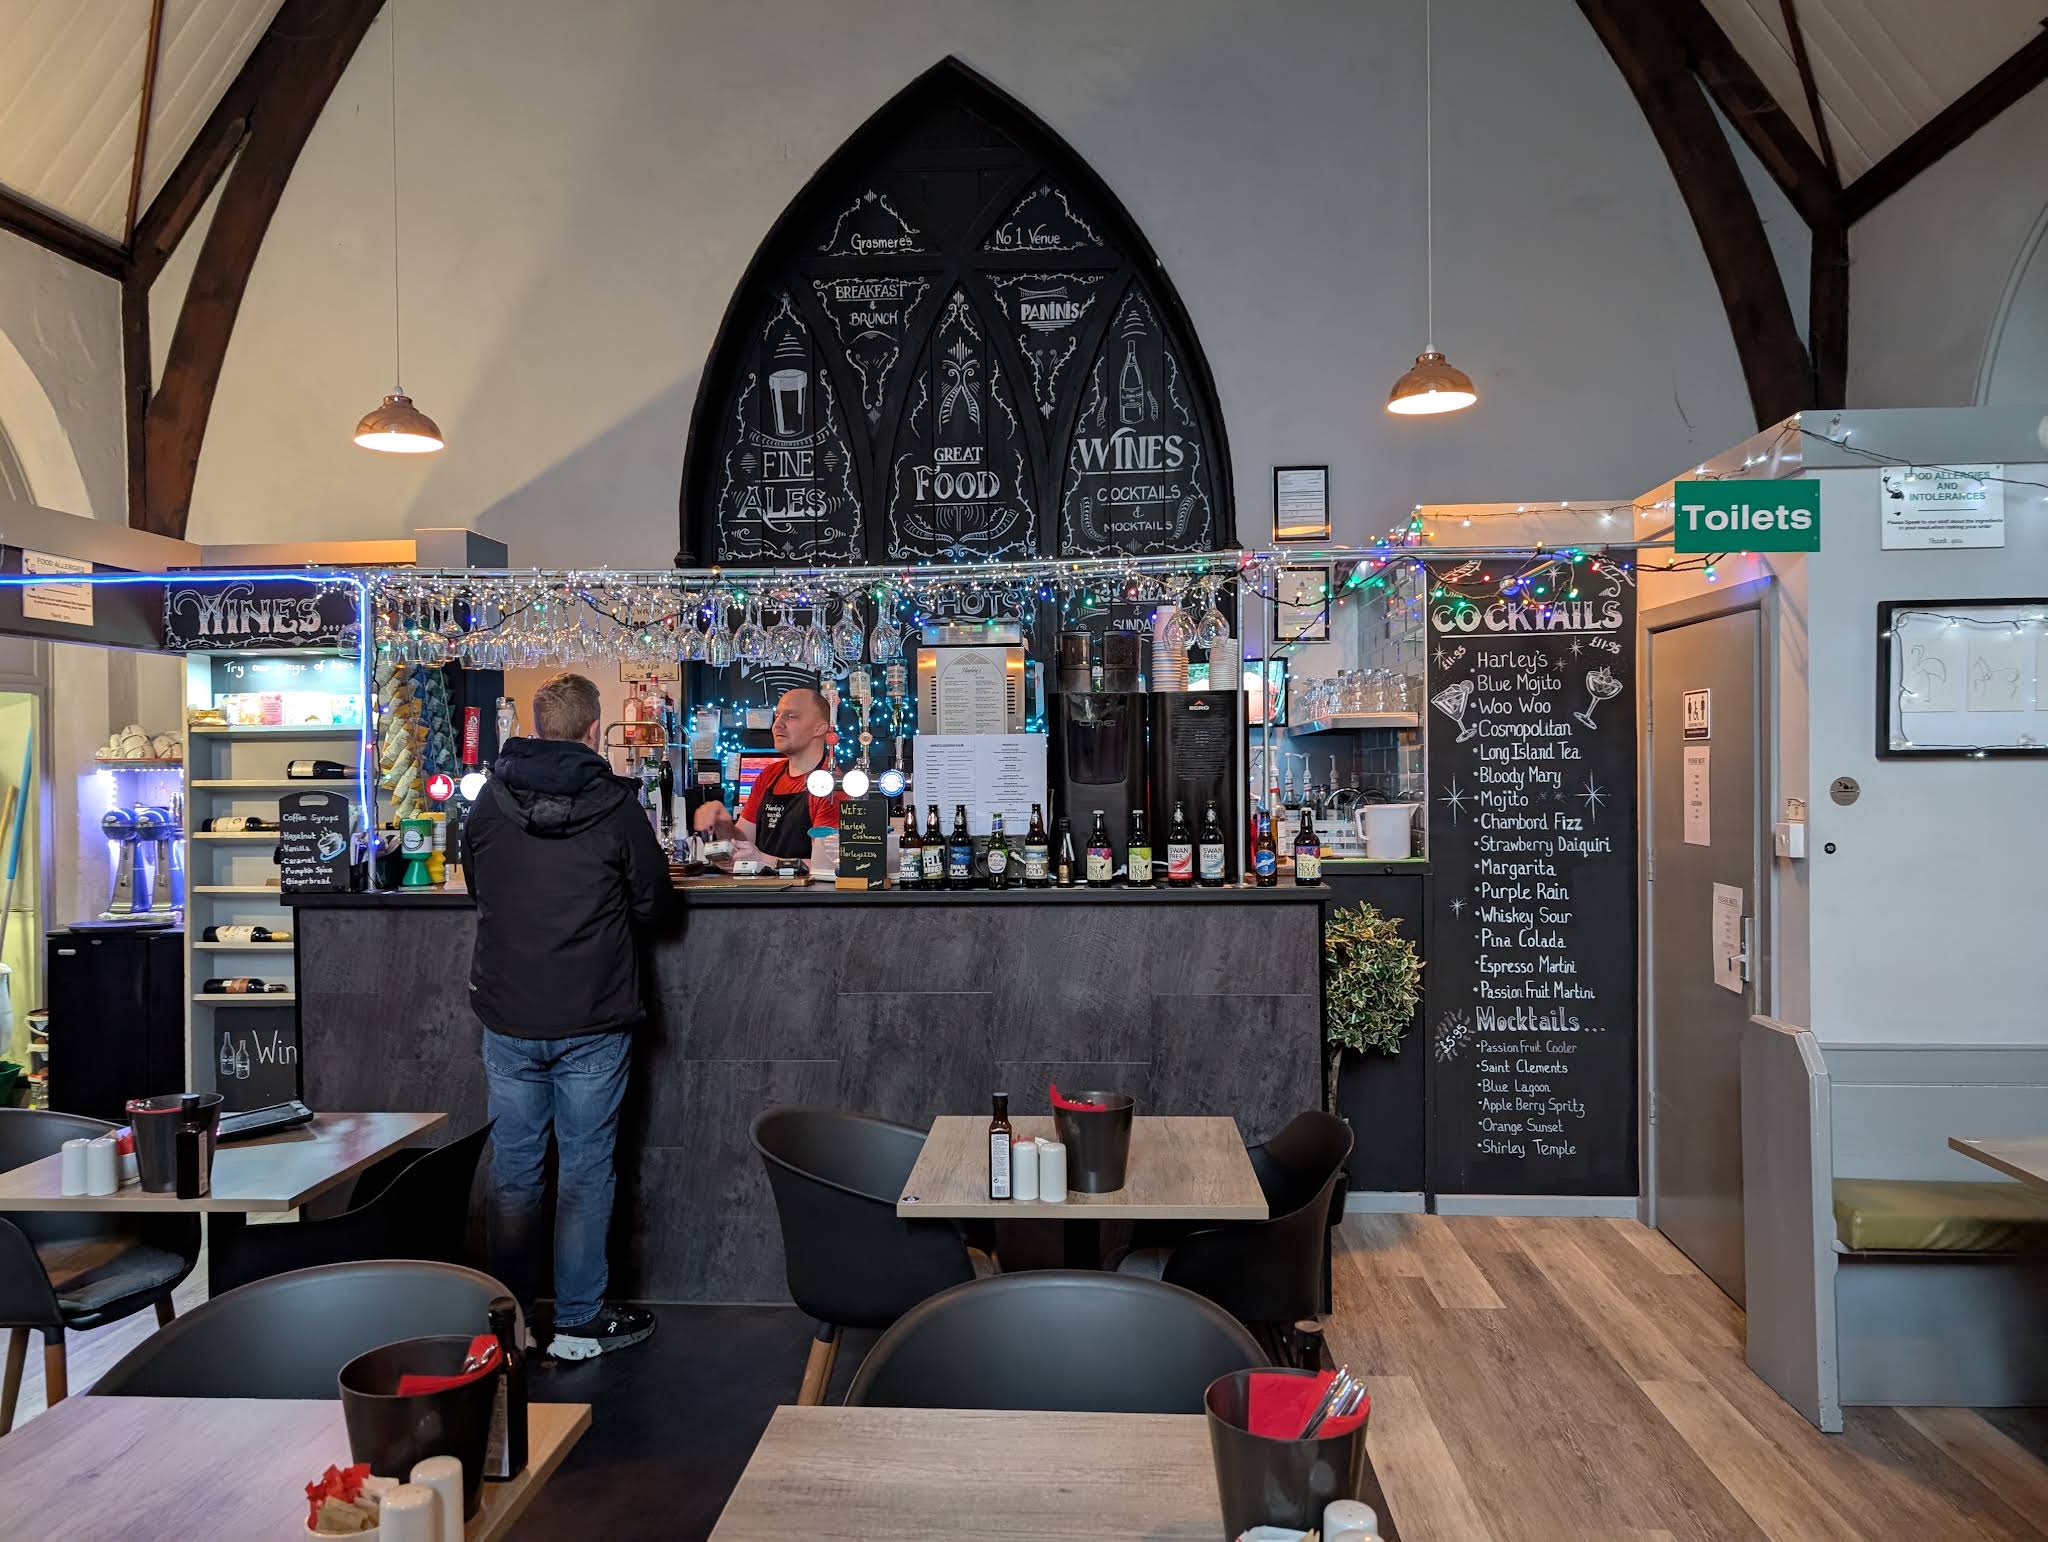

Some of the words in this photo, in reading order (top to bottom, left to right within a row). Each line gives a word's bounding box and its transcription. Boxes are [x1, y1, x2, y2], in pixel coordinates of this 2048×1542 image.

[996, 222, 1014, 245] No
[1016, 227, 1022, 245] 1
[1028, 223, 1062, 245] Venue
[851, 234, 913, 256] Grasmere's
[835, 282, 907, 299] BREAKFAST
[850, 310, 898, 328] BRUNCH
[1021, 301, 1081, 321] PANINIS
[934, 446, 984, 462] GREAT
[1077, 427, 1184, 470] WINES
[763, 450, 814, 478] FINE
[913, 465, 1001, 501] FOOD
[1904, 472, 1933, 481] FOOD
[1935, 471, 1991, 480] ALLERGIES
[1097, 484, 1182, 502] COCKTAILS
[1937, 482, 1958, 490] AND
[737, 485, 827, 520] ALES
[1909, 492, 1986, 501] INTOLERANCES
[1104, 521, 1173, 533] MOCKTAILS
[1682, 504, 1813, 531] Toilets
[37, 557, 53, 566] FOOD
[916, 590, 1024, 618] SHOTS
[1431, 600, 1623, 633] COCKTAILS
[223, 661, 244, 679] Try
[314, 660, 325, 672] of
[1477, 650, 1549, 674] Harley's
[1477, 674, 1512, 692] Blue
[1516, 673, 1562, 696] Mojito
[1478, 696, 1512, 714] Woo
[1519, 696, 1552, 714] Woo
[1478, 719, 1573, 743] Cosmopolitan
[1480, 743, 1510, 766] Long
[1510, 742, 1555, 760] Island
[1557, 741, 1581, 760] Tea
[1480, 766, 1525, 791] Bloody
[1528, 765, 1562, 789] Mary
[1480, 789, 1529, 812] Mojito
[282, 813, 307, 822] Coffee
[311, 814, 339, 824] Syrups
[840, 820, 866, 834] Harley's
[1480, 812, 1549, 831] Chambord
[1554, 812, 1584, 831] Fizz
[283, 844, 311, 852] Vanilla
[1480, 835, 1553, 858] Strawberry
[1558, 836, 1612, 858] Daiquiri
[283, 856, 317, 864] Caramel
[923, 856, 942, 868] FELL
[1480, 858, 1557, 880] Margarita
[285, 867, 314, 877] Pumpkin
[316, 866, 333, 875] Spice
[285, 877, 331, 886] Gingerbread
[1481, 882, 1533, 904] Purple
[1536, 882, 1570, 900] Rain
[1480, 906, 1534, 931] Whiskey
[1539, 906, 1573, 924] Sour
[1481, 927, 1513, 948] Pina
[1518, 928, 1567, 949] Colada
[1480, 954, 1534, 979] Espresso
[1538, 955, 1577, 974] Martini
[1480, 980, 1524, 999] Passion
[1525, 980, 1550, 999] Fruit
[1553, 981, 1596, 999] Martini
[1480, 1040, 1520, 1054] Passion
[1520, 1040, 1542, 1053] Fruit
[1546, 1040, 1578, 1054] Cooler
[1480, 1060, 1510, 1073] Saint
[1516, 1059, 1568, 1074] Clements
[1482, 1078, 1509, 1093] Blue
[1514, 1079, 1551, 1097] Lagoon
[1482, 1097, 1512, 1114] Apple
[1515, 1097, 1545, 1115] Berry
[1548, 1097, 1586, 1119] Spritz
[1482, 1117, 1523, 1136] Orange
[1526, 1118, 1564, 1132] Sunset
[1482, 1138, 1525, 1159] Shirley
[1532, 1138, 1577, 1159] Temple
